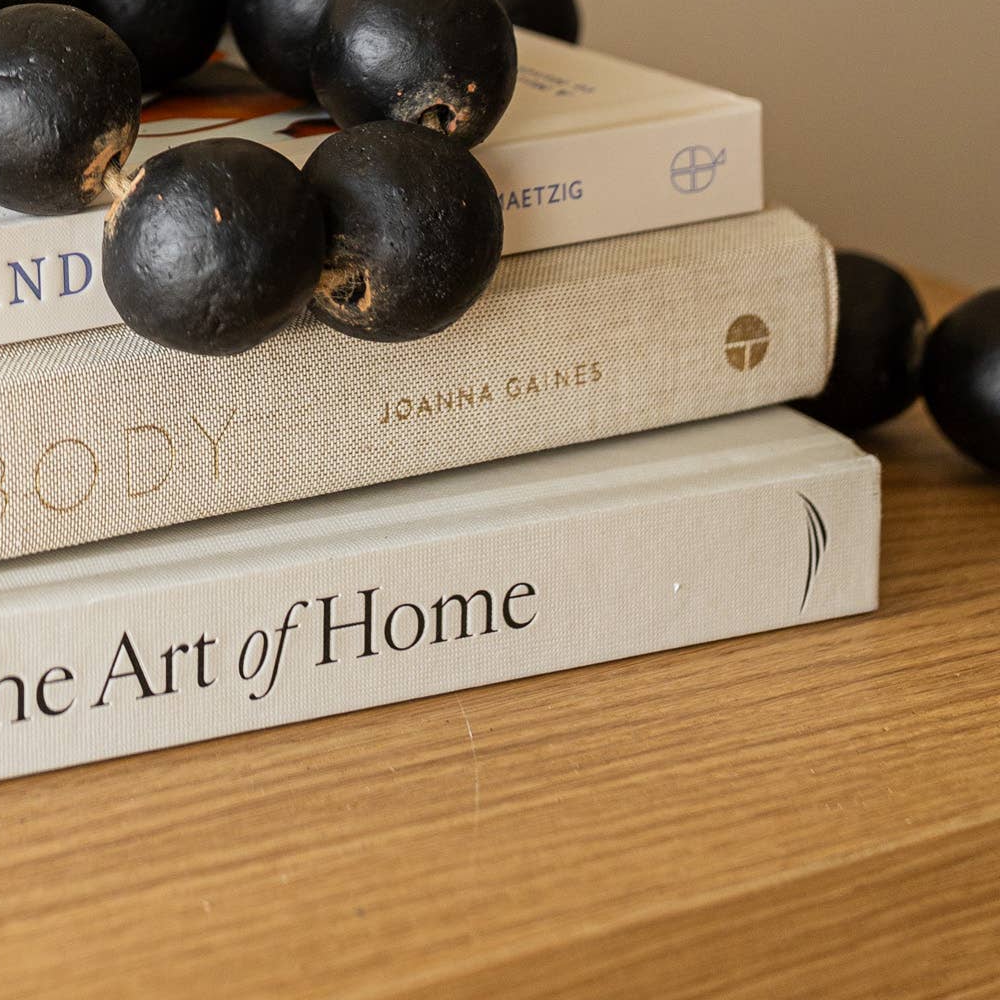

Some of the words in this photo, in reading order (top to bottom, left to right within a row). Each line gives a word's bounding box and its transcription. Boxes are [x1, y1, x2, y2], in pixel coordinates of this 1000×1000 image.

[380, 382, 494, 424] JOANNA
[506, 361, 603, 400] GAINES
[90, 630, 217, 709] Art
[238, 600, 309, 701] of
[315, 579, 538, 667] Home
